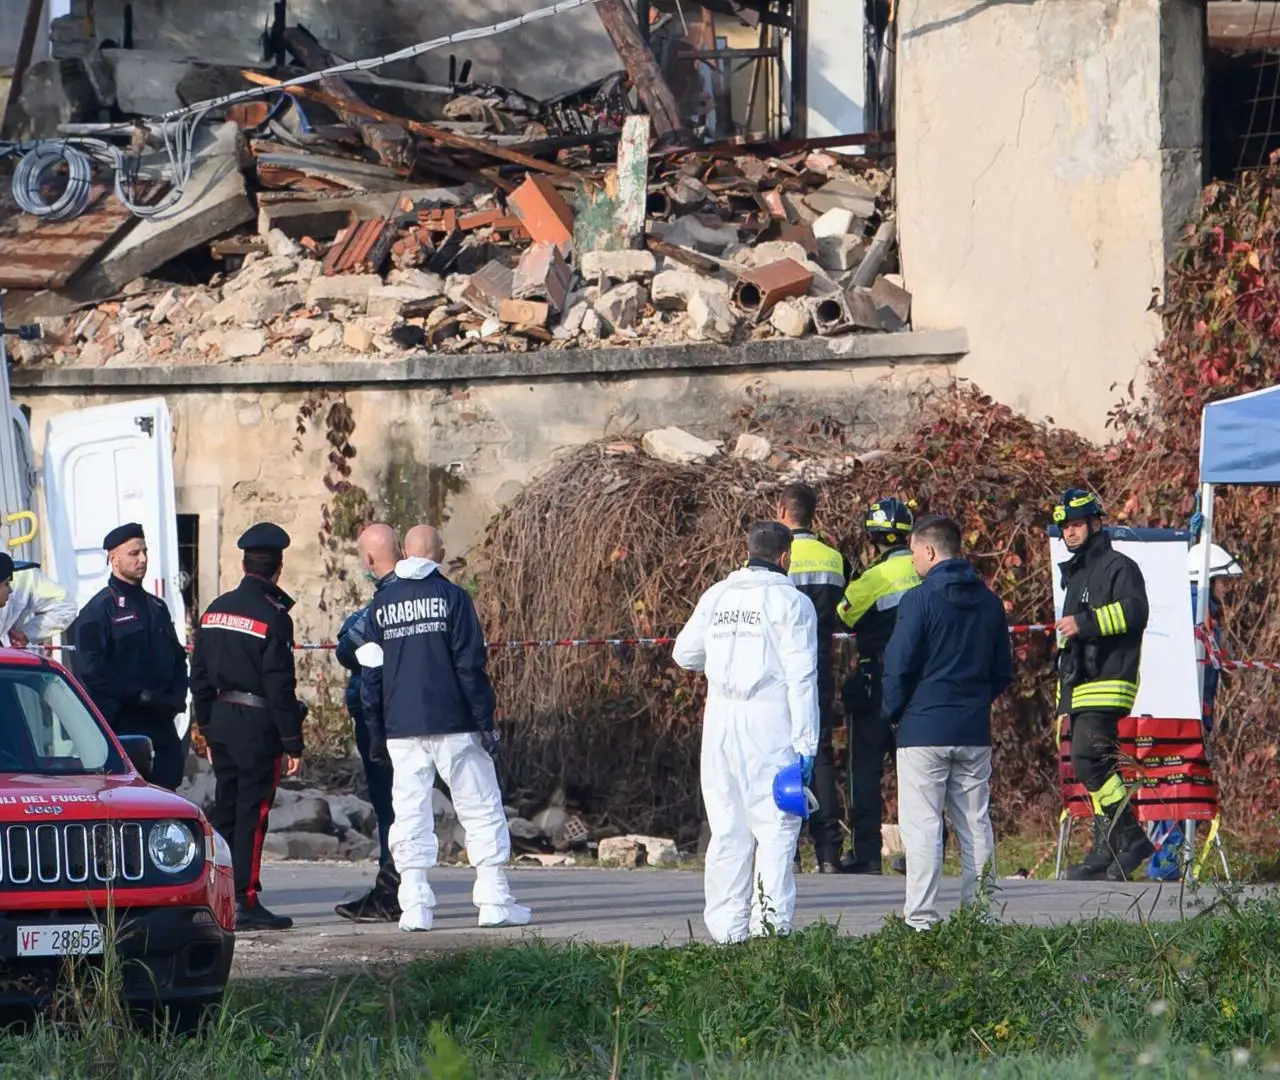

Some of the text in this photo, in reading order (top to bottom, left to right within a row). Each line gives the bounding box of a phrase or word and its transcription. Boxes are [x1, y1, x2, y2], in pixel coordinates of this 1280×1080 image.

[376, 598, 449, 628] CARABINIER
[20, 795, 48, 803] DEL
[52, 794, 97, 802] FUOCO
[24, 805, 63, 815] Jeep
[21, 931, 40, 950] VF
